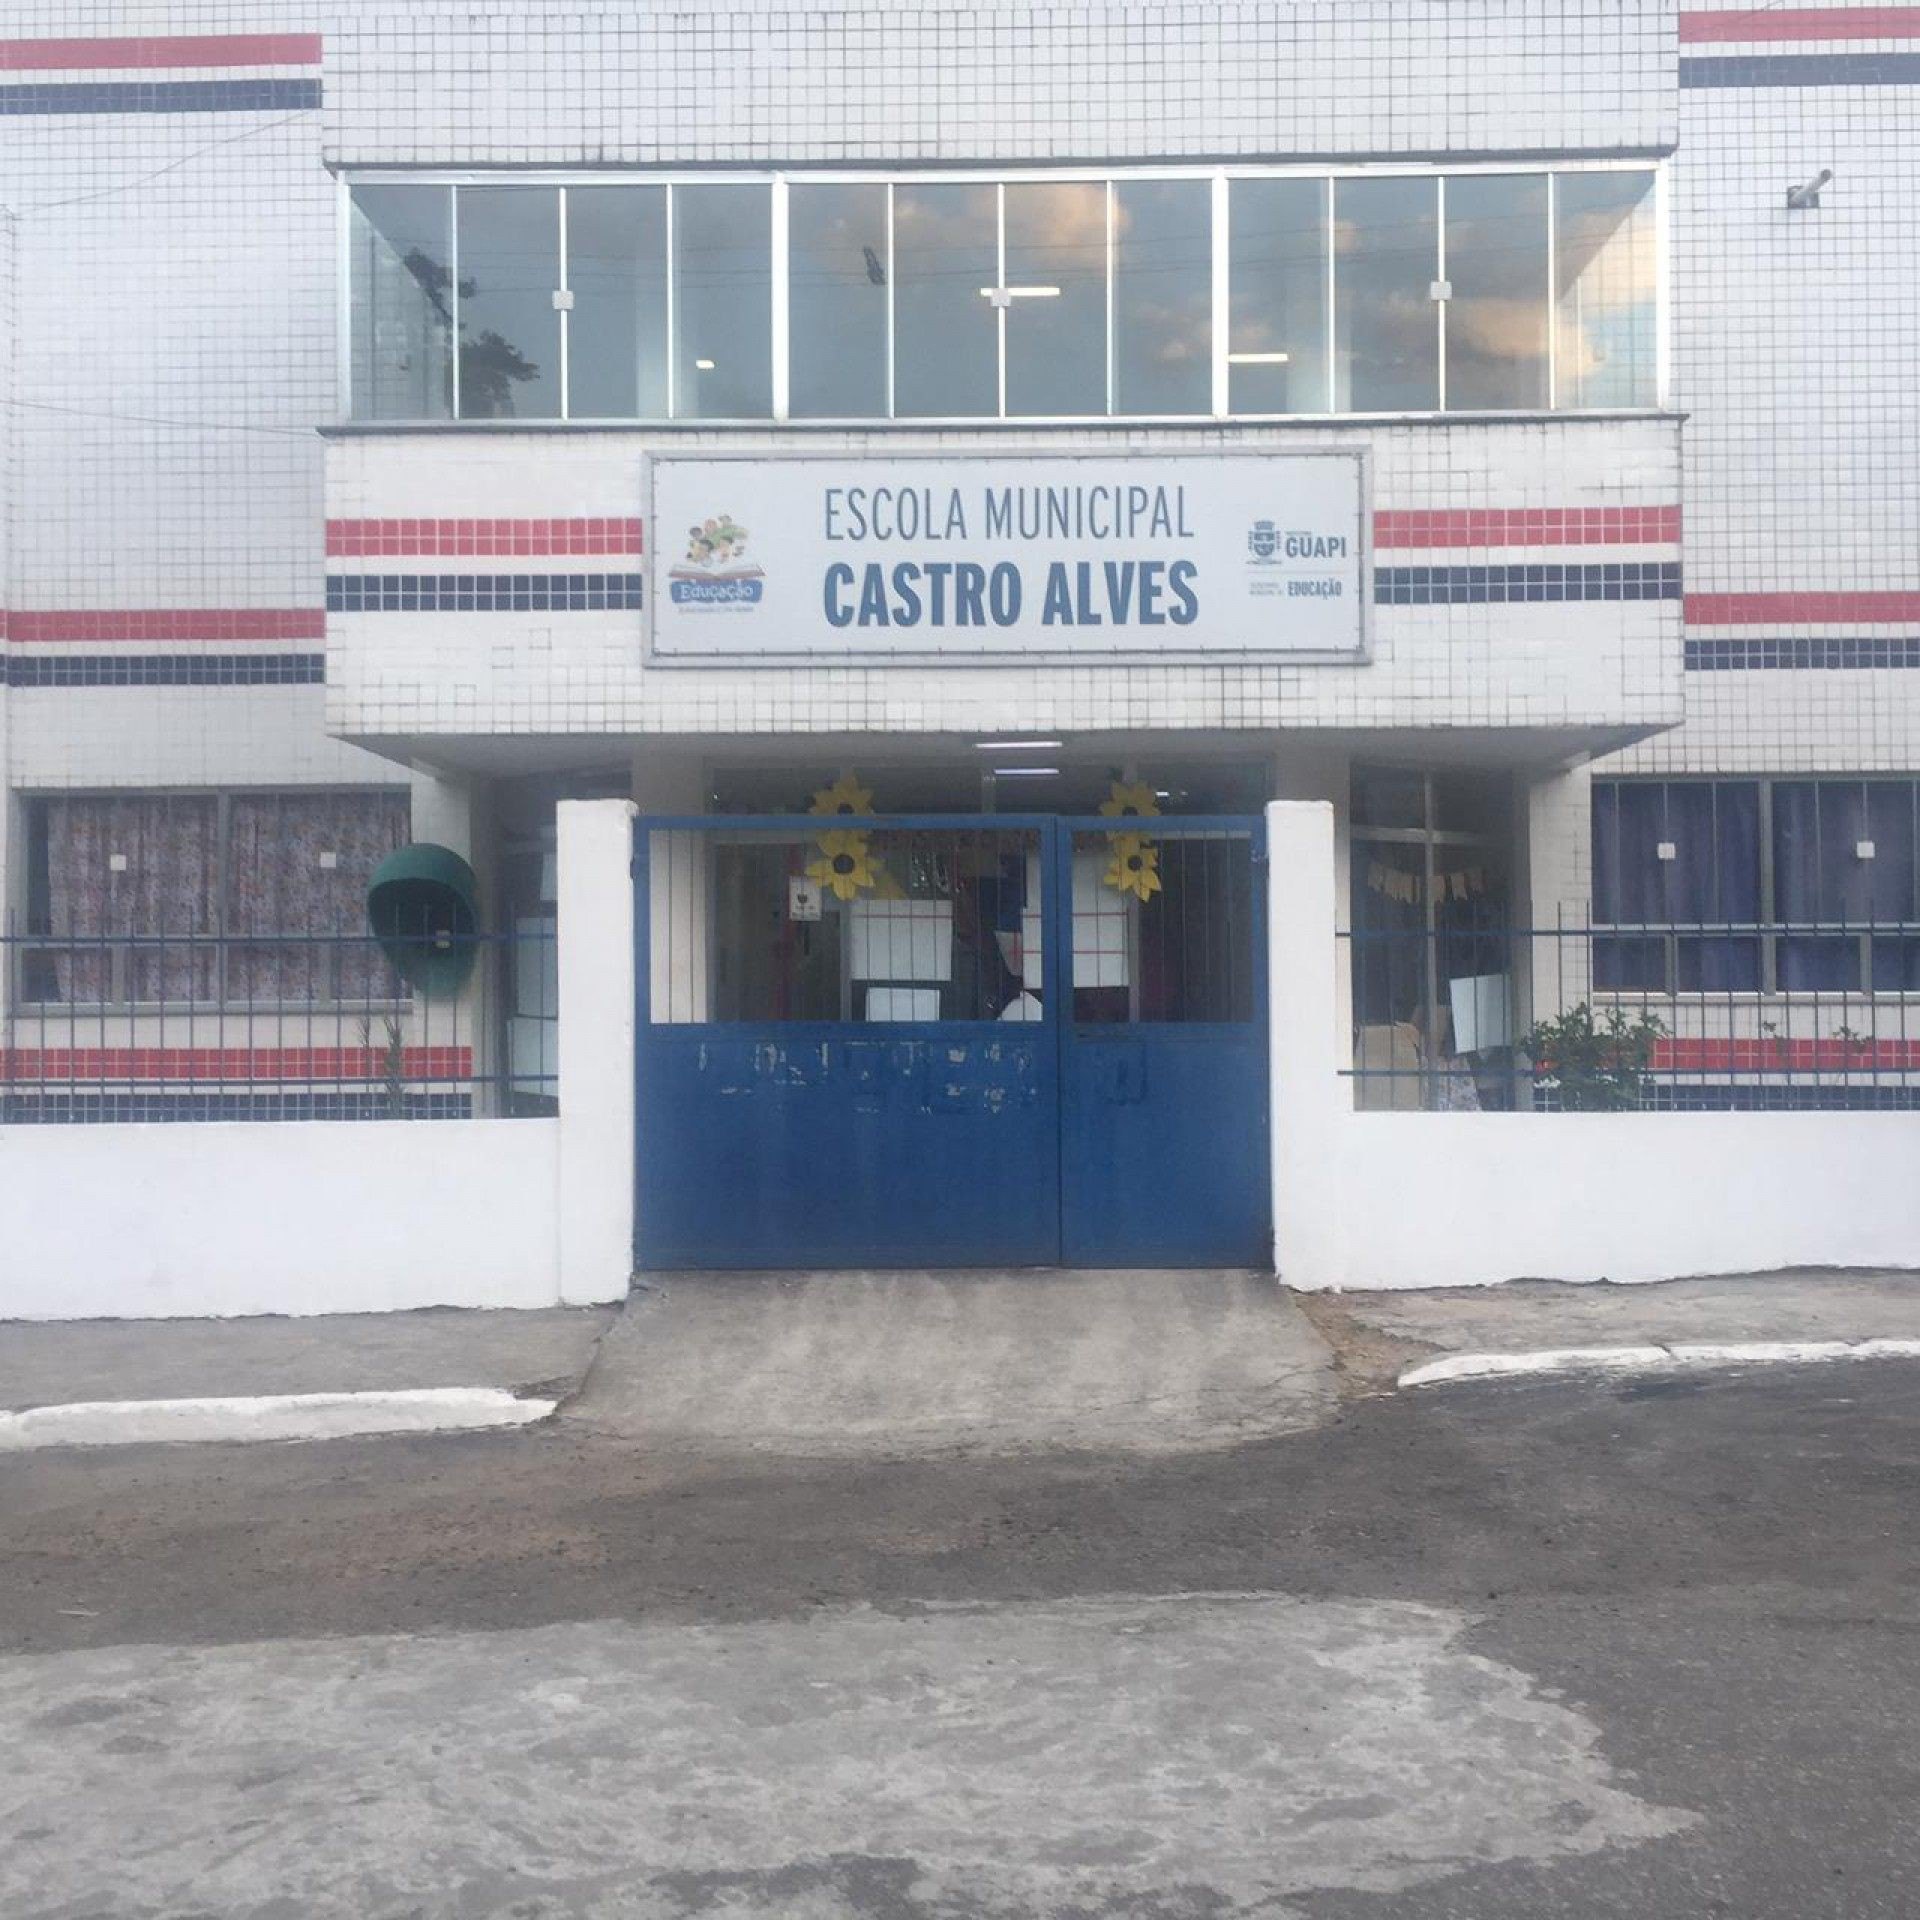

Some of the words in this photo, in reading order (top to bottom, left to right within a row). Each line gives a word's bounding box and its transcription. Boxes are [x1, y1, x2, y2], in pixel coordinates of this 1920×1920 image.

[825, 486, 966, 540] ESCOLA
[986, 485, 1194, 539] MUNICIPAL
[1285, 536, 1346, 558] GUAPI
[680, 581, 754, 600] Educação
[824, 562, 1021, 627] CASTRO
[1042, 559, 1198, 625] ALVES
[1287, 579, 1342, 600] EDUCAÇÃO
